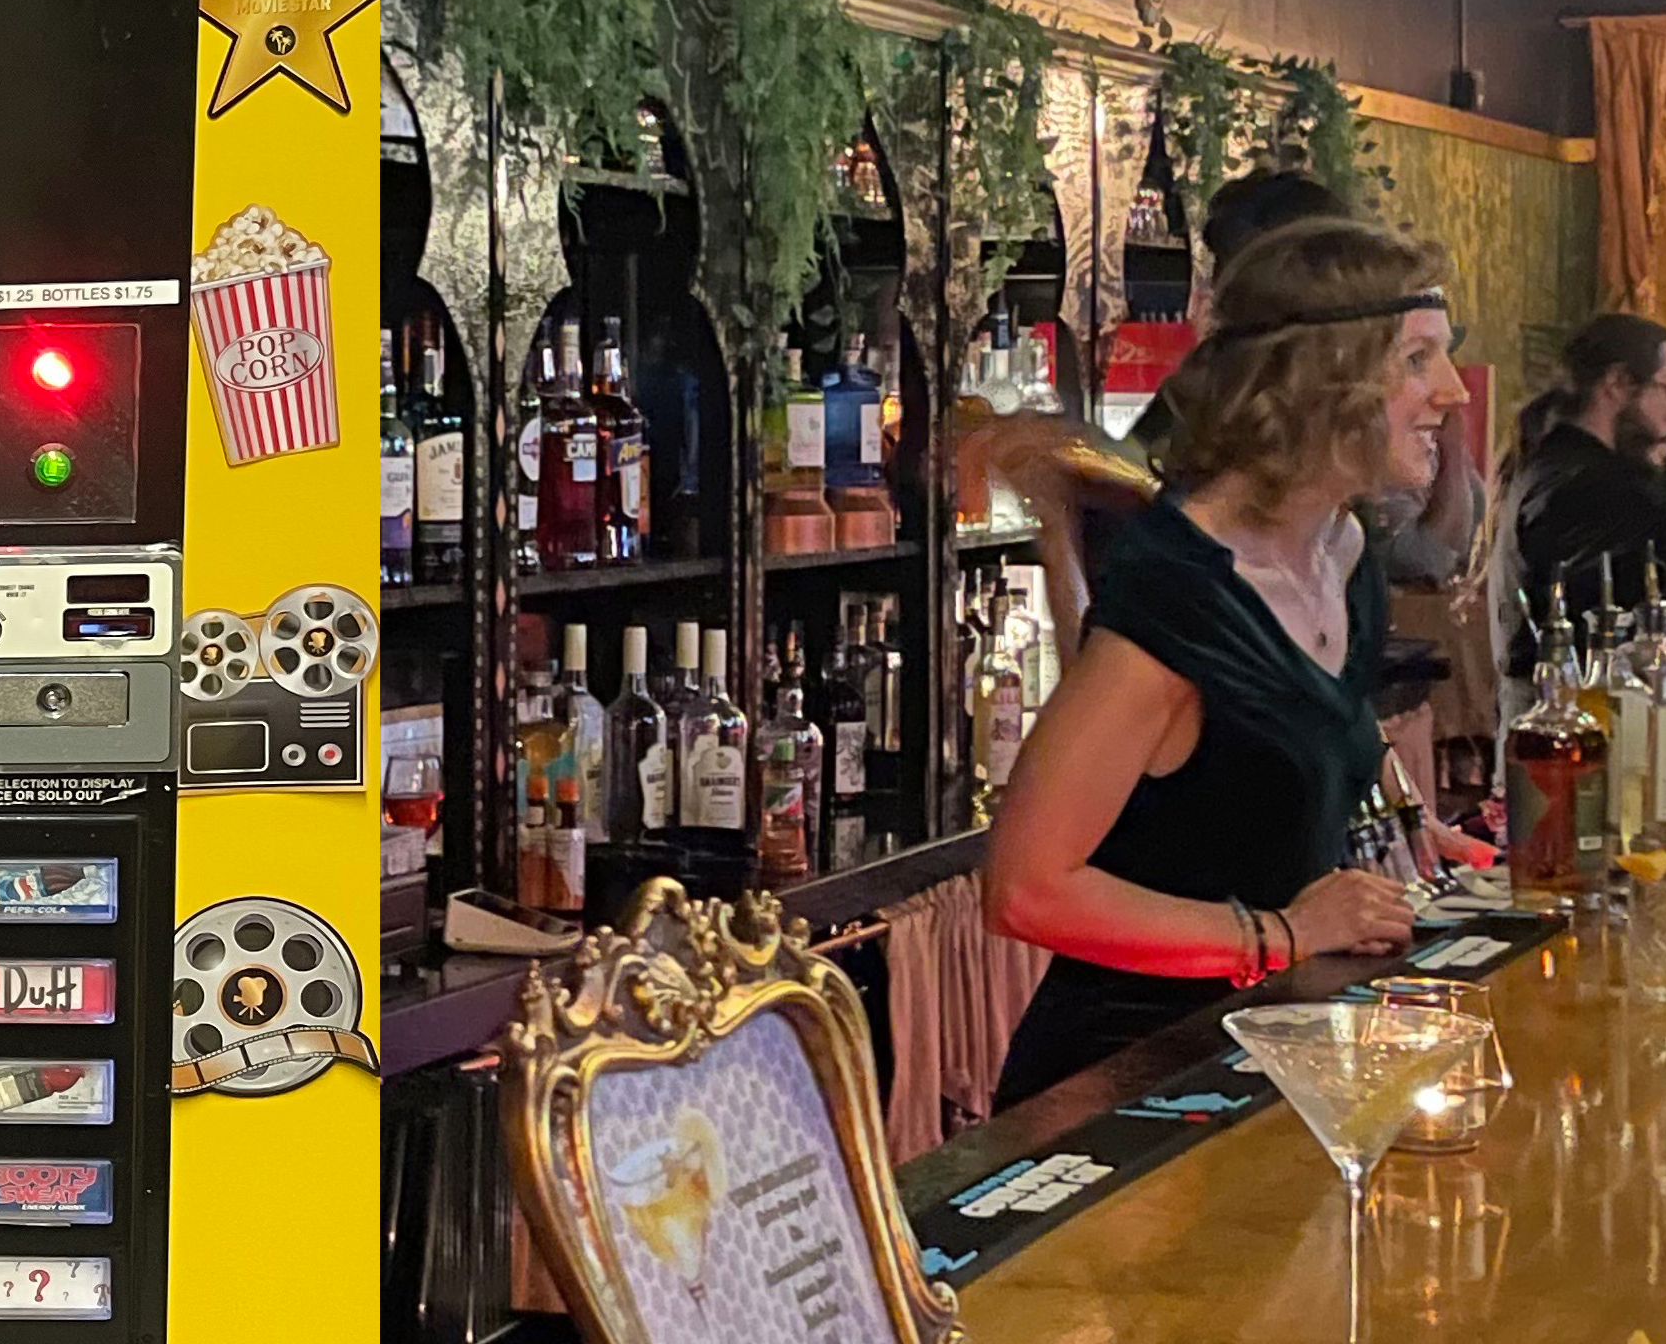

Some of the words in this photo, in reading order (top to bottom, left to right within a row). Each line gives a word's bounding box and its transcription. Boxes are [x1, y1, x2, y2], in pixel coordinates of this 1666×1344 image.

[235, 0, 288, 16] MOVIE
[42, 287, 110, 302] BOTTLES
[114, 285, 153, 300] $1.75
[238, 332, 295, 362] POP
[230, 350, 309, 384] CORN
[61, 778, 79, 789] TO
[81, 778, 135, 789] DISPLAY
[15, 790, 33, 801] OR
[37, 790, 73, 801] SOLD
[75, 790, 103, 801] OUT
[3, 906, 67, 914] PEPSI-COLA
[4, 965, 77, 1013] Duff
